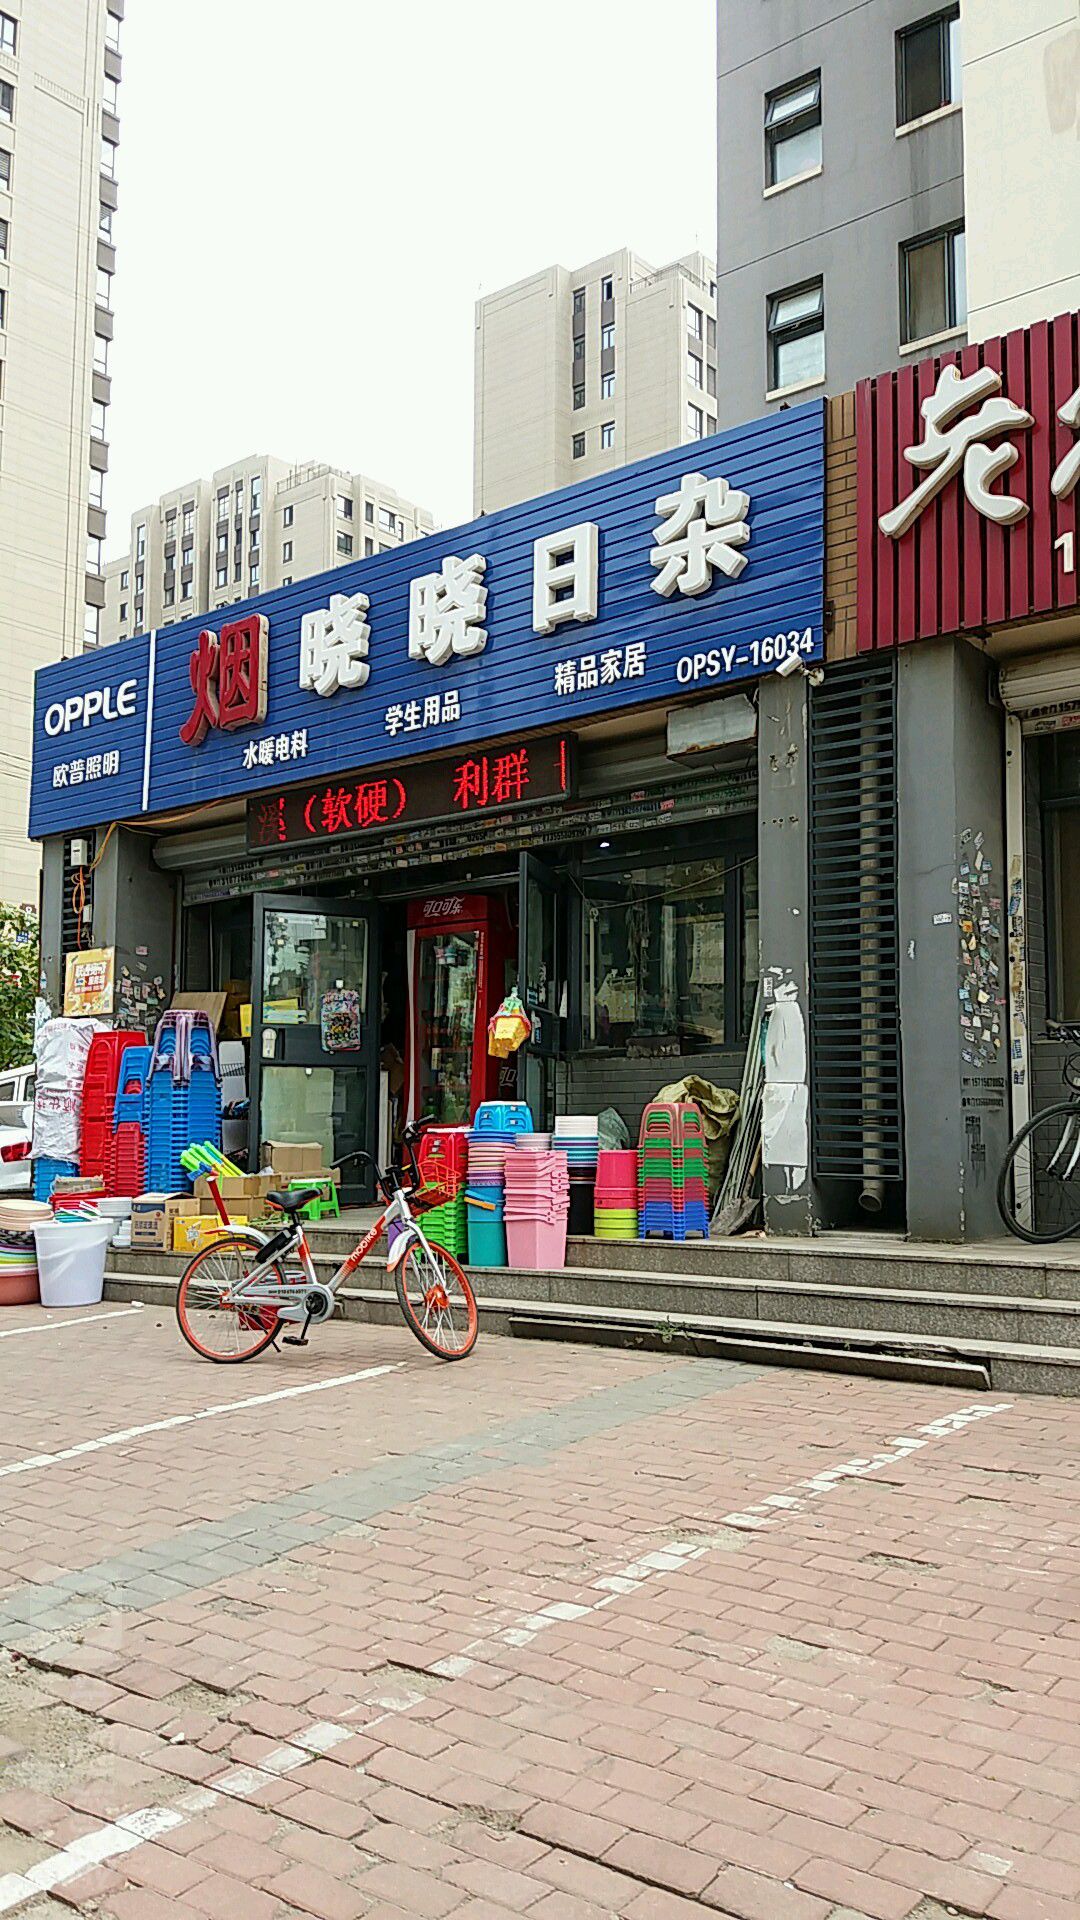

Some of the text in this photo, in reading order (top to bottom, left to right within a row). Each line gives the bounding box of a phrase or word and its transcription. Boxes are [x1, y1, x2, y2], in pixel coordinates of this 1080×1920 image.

[299, 472, 751, 698] 晓晓日杂
[179, 612, 270, 747] 烟
[554, 641, 647, 696] 精品家居
[676, 627, 815, 683] OPSY-16034
[44, 678, 138, 736] OPPLE
[384, 690, 461, 736] 学生用品
[52, 750, 120, 788] 欧普照明
[242, 729, 309, 769] 水暖电料
[453, 748, 530, 809] 利群
